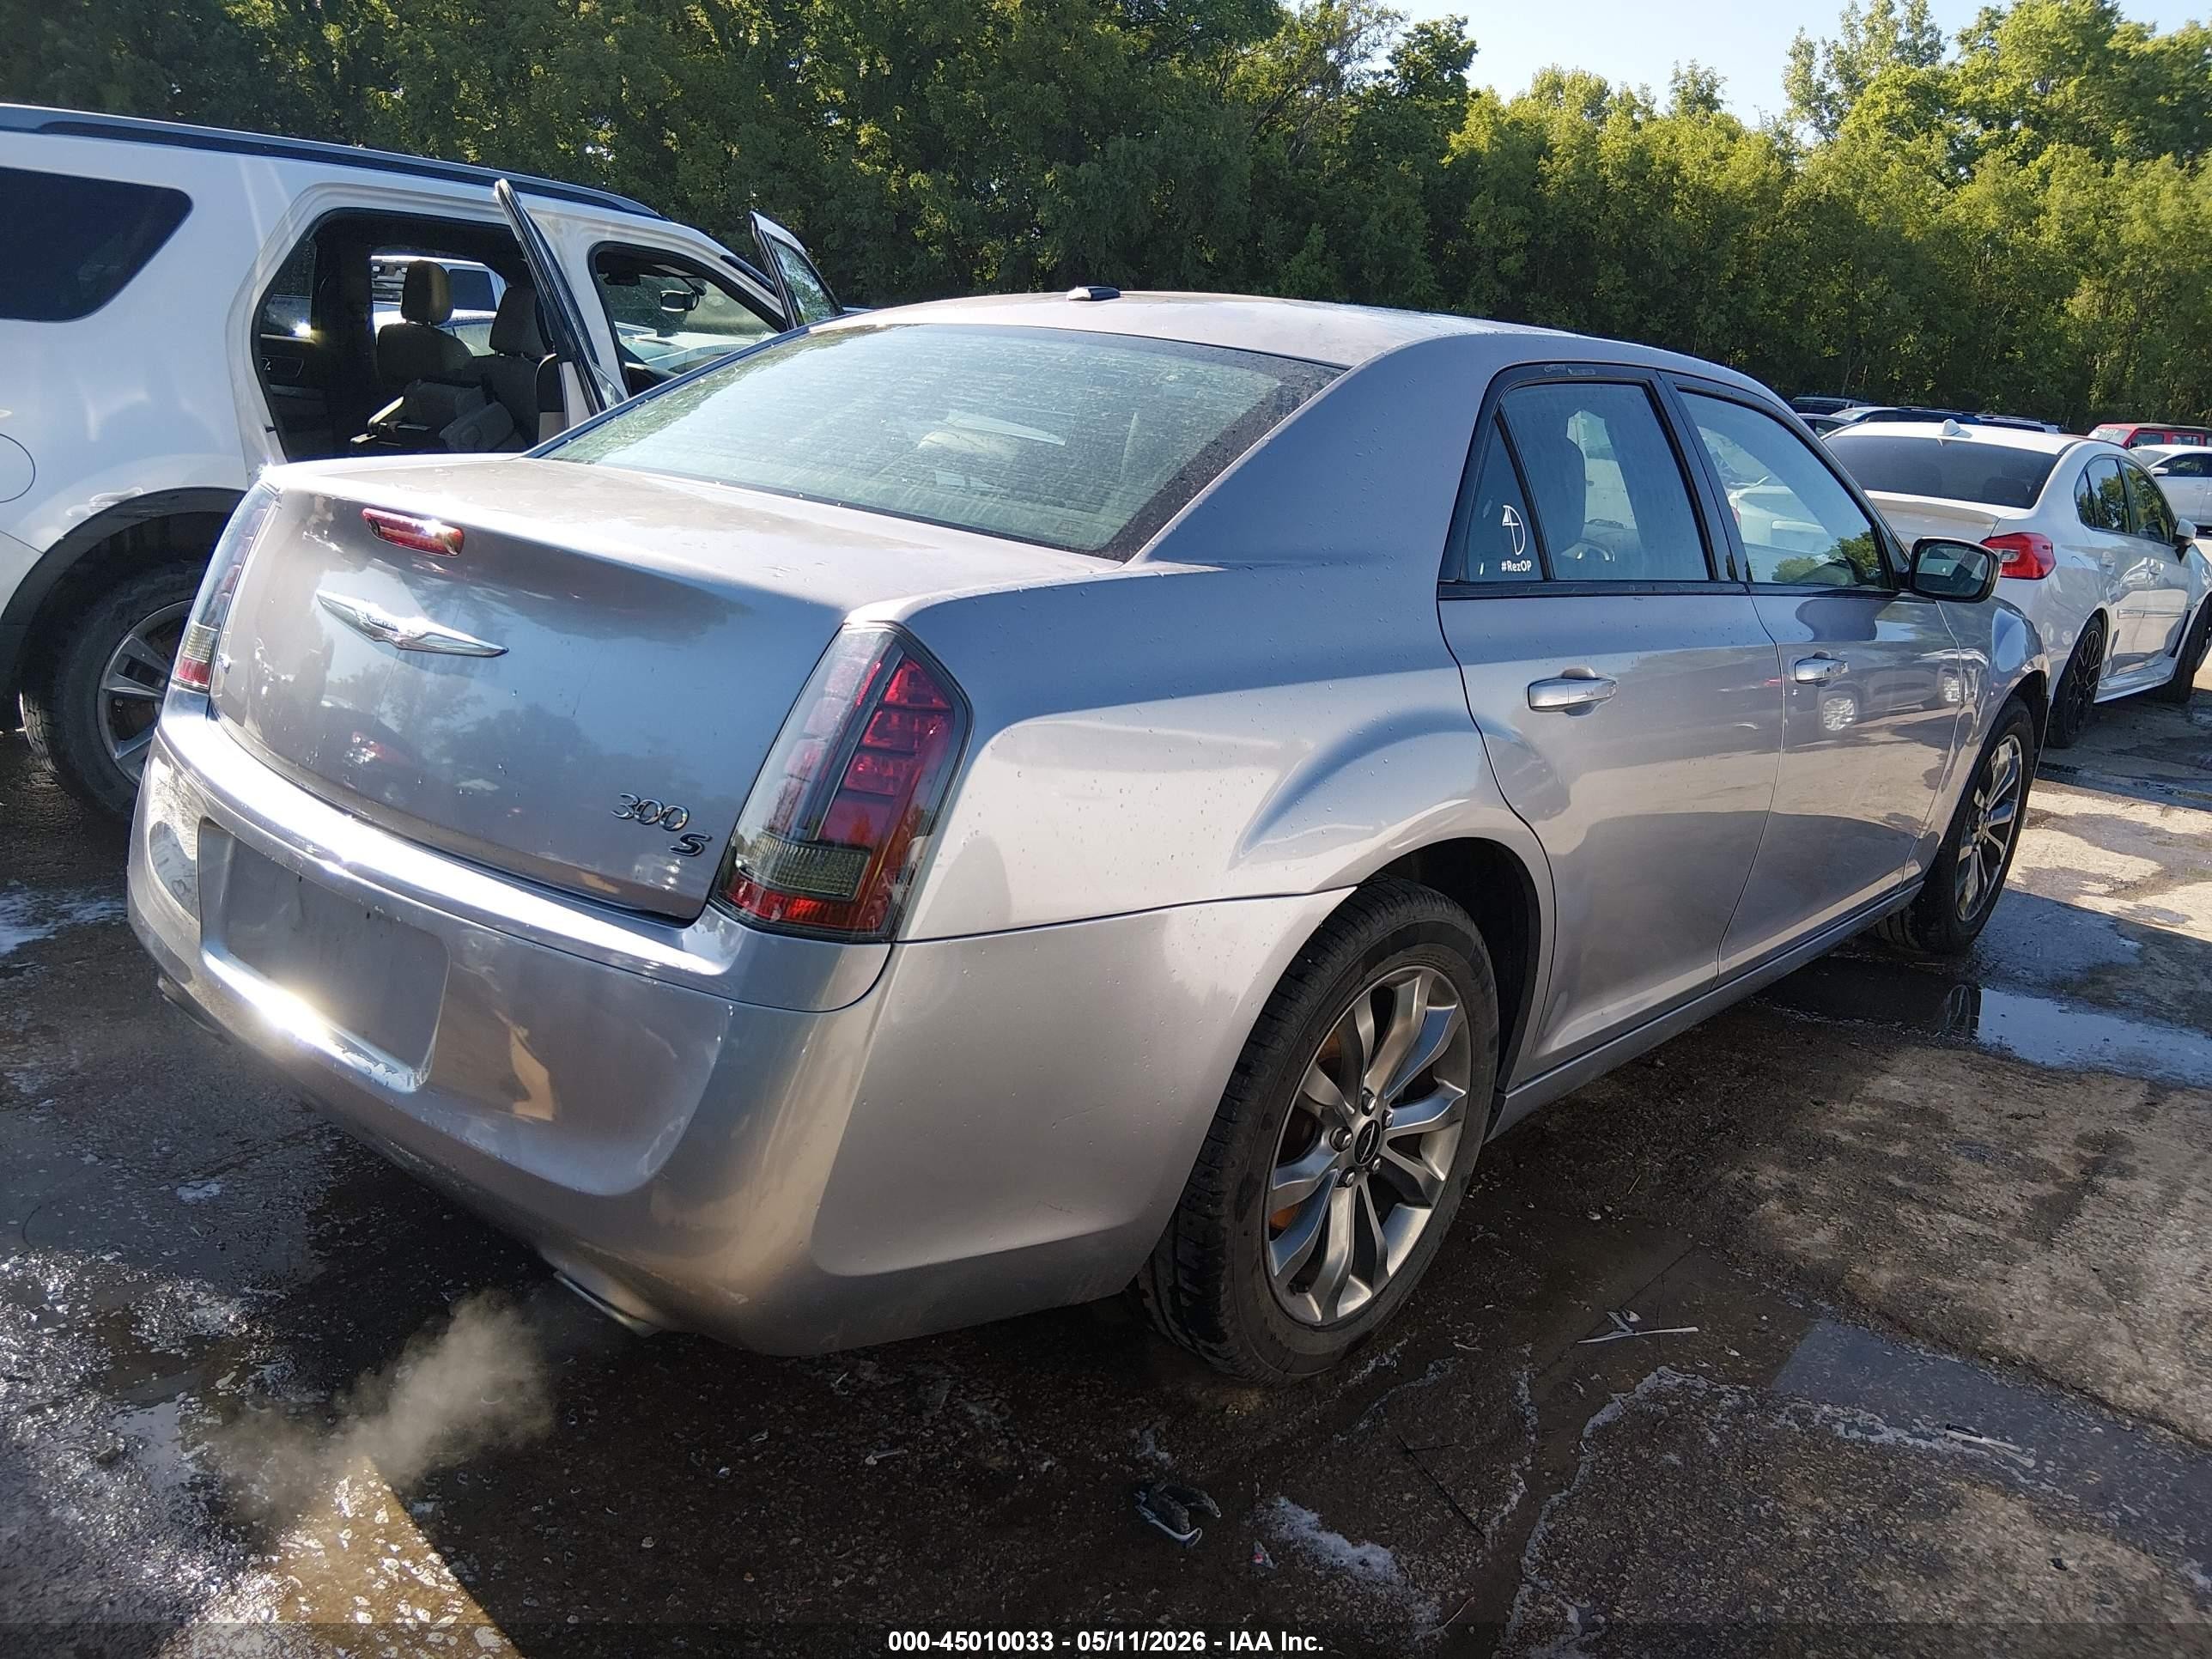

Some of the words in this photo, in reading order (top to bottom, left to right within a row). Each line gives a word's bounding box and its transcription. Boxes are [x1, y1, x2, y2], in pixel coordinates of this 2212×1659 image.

[1501, 560, 1532, 572] #RezOP
[611, 792, 690, 831] 300
[669, 831, 713, 856] S
